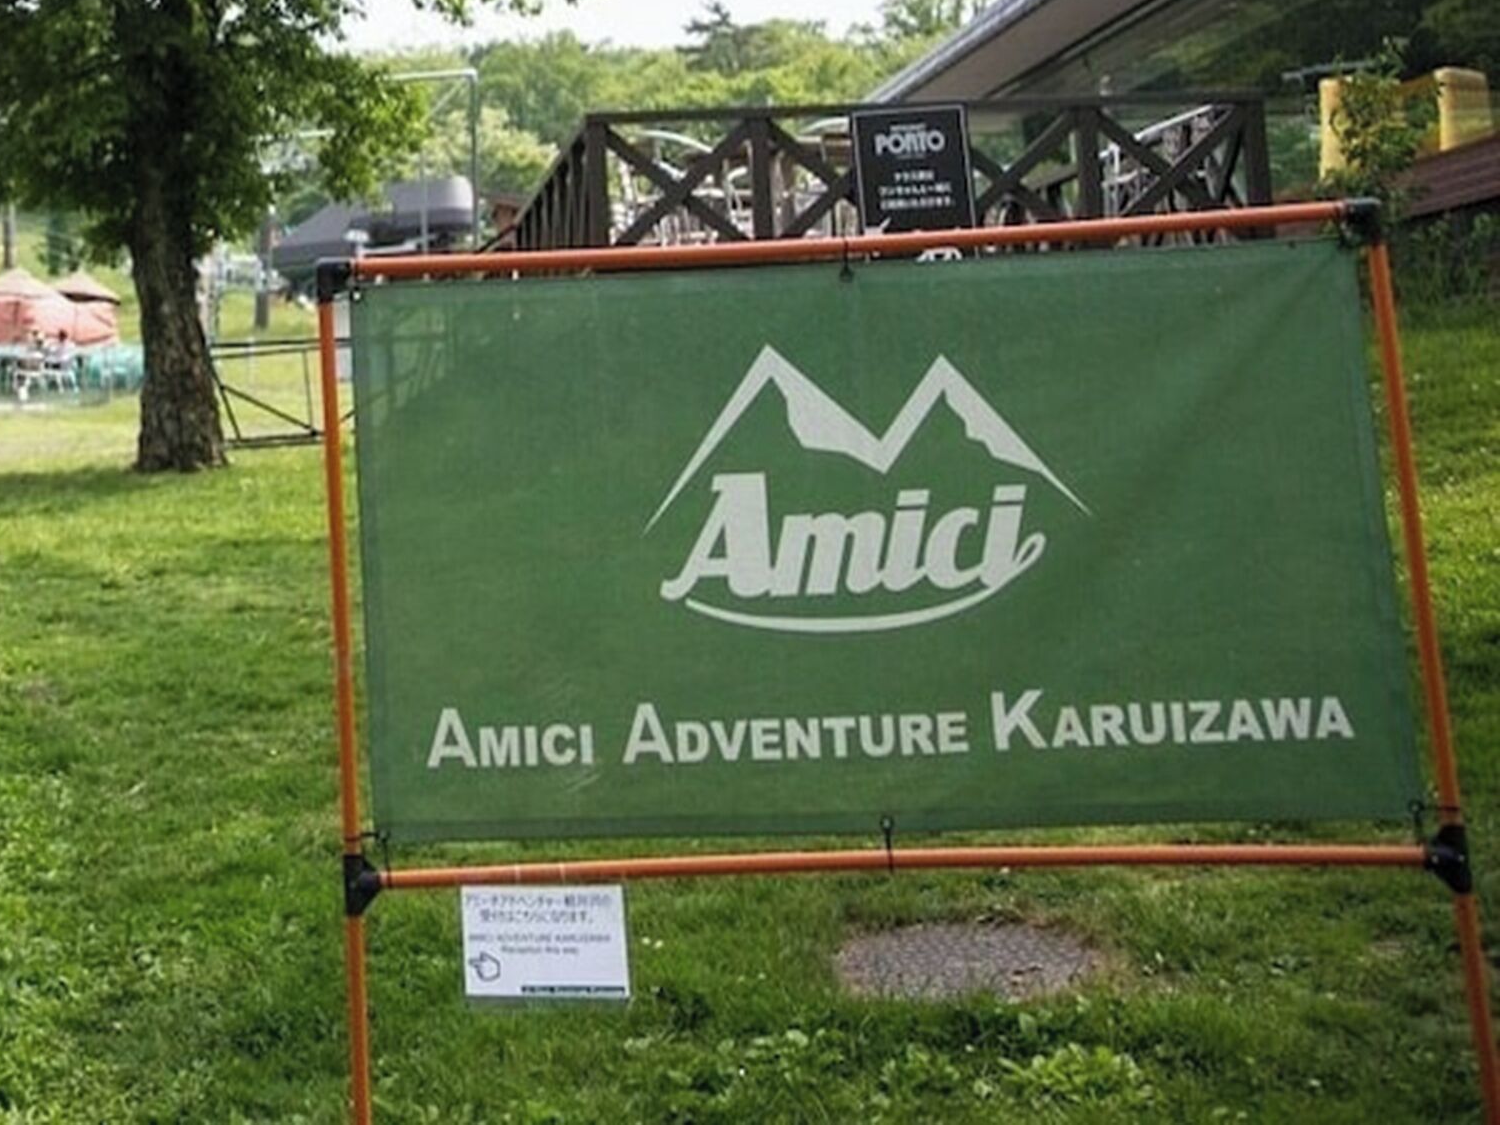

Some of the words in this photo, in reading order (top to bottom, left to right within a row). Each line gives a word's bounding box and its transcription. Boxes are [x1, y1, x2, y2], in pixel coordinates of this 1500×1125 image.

[875, 130, 945, 155] PORTO
[661, 472, 1046, 602] Amici
[427, 708, 594, 768] AMICI
[622, 703, 970, 763] ADVENTURE
[991, 689, 1355, 751] KARUIZAWA
